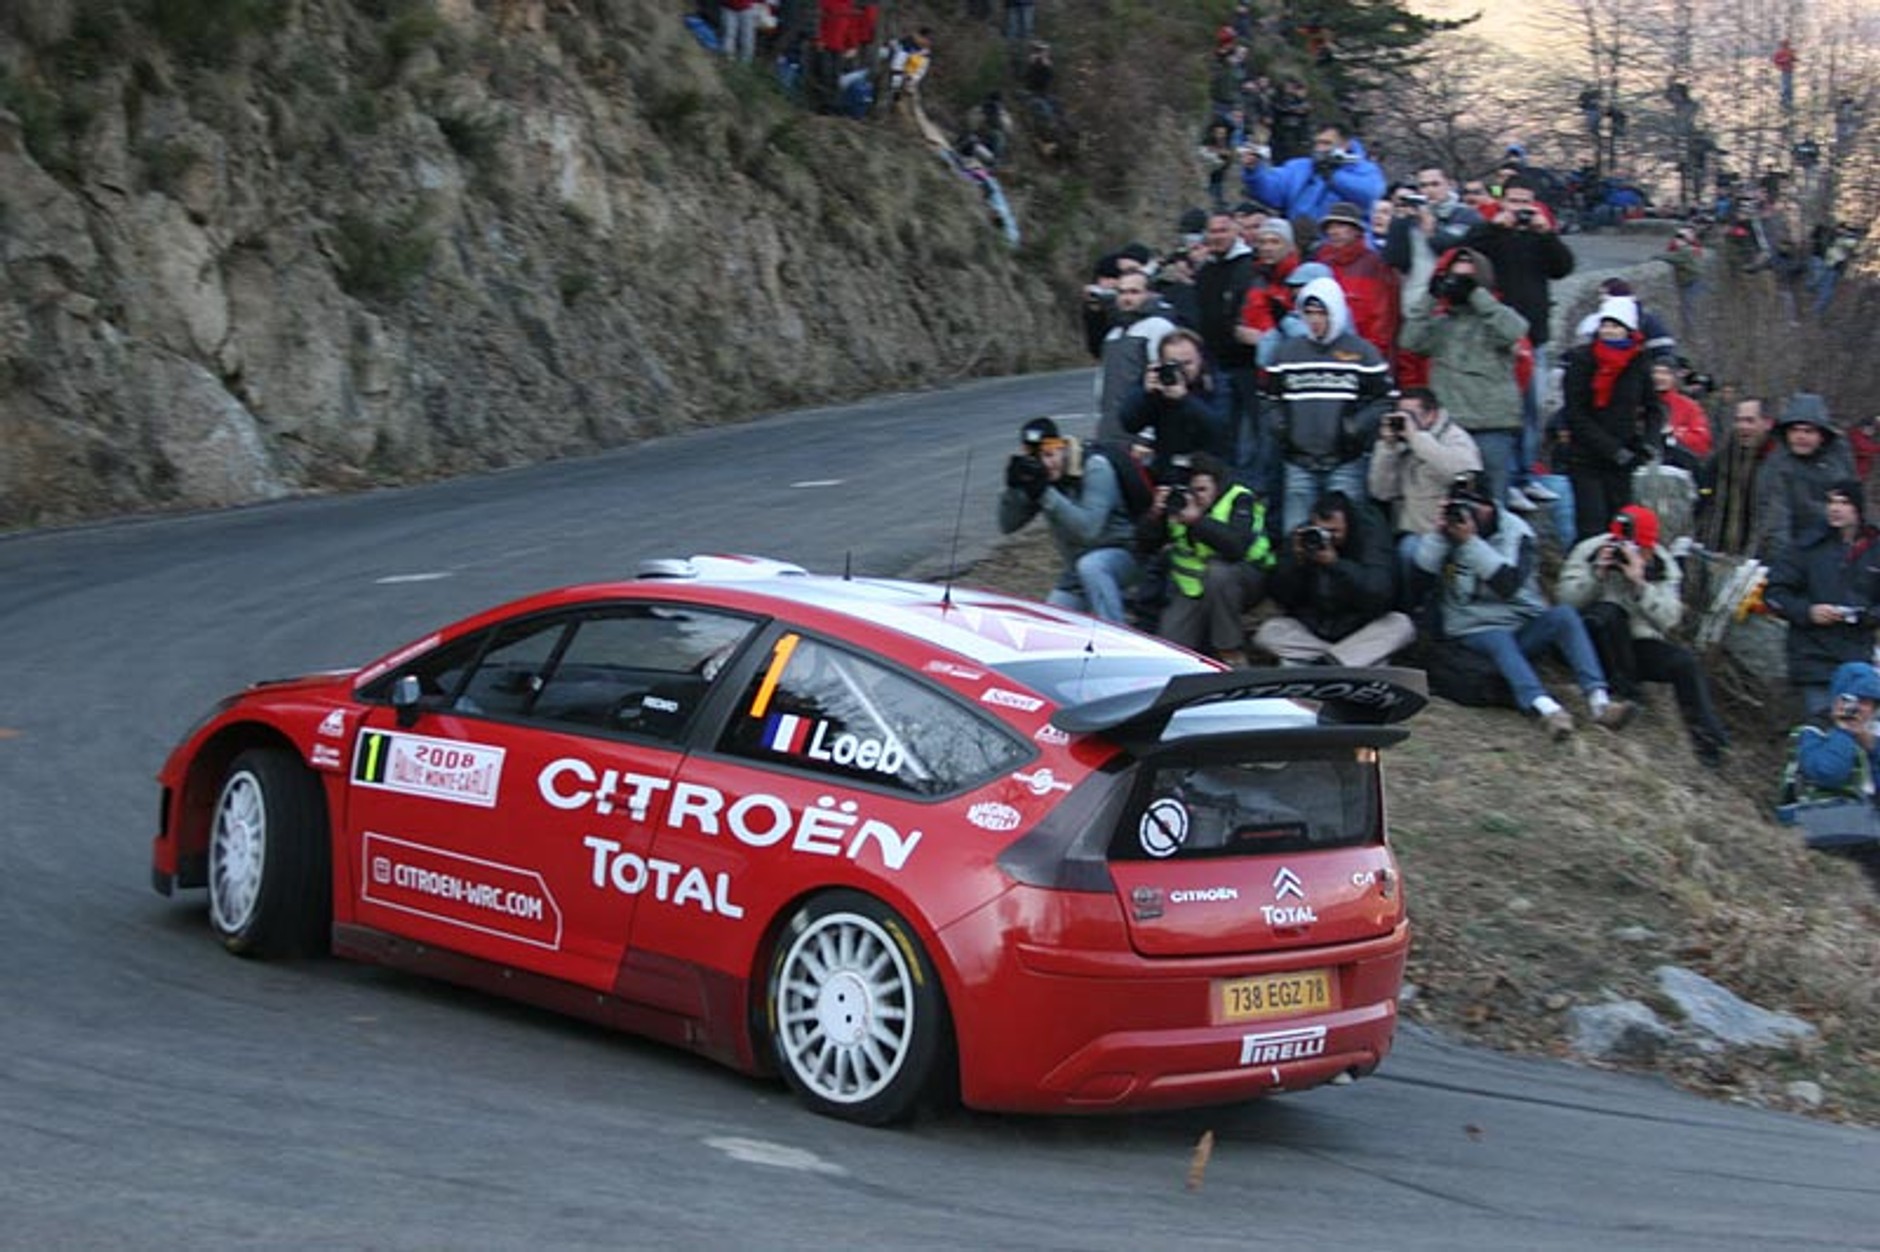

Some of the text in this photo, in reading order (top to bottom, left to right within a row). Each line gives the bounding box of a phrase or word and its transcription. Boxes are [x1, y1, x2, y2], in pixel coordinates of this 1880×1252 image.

[750, 634, 800, 718] 1
[366, 735, 381, 781] 1
[415, 744, 475, 769] 2008
[808, 720, 903, 774] Loeb
[537, 758, 922, 871] CITROËN
[394, 863, 543, 921] CITROEN-WRC.COM
[583, 836, 744, 919] TOTAL
[1260, 905, 1317, 924] TOTAL
[1231, 976, 1324, 1012] 738 EGZ 78
[1240, 1025, 1328, 1065] PIRELLI
